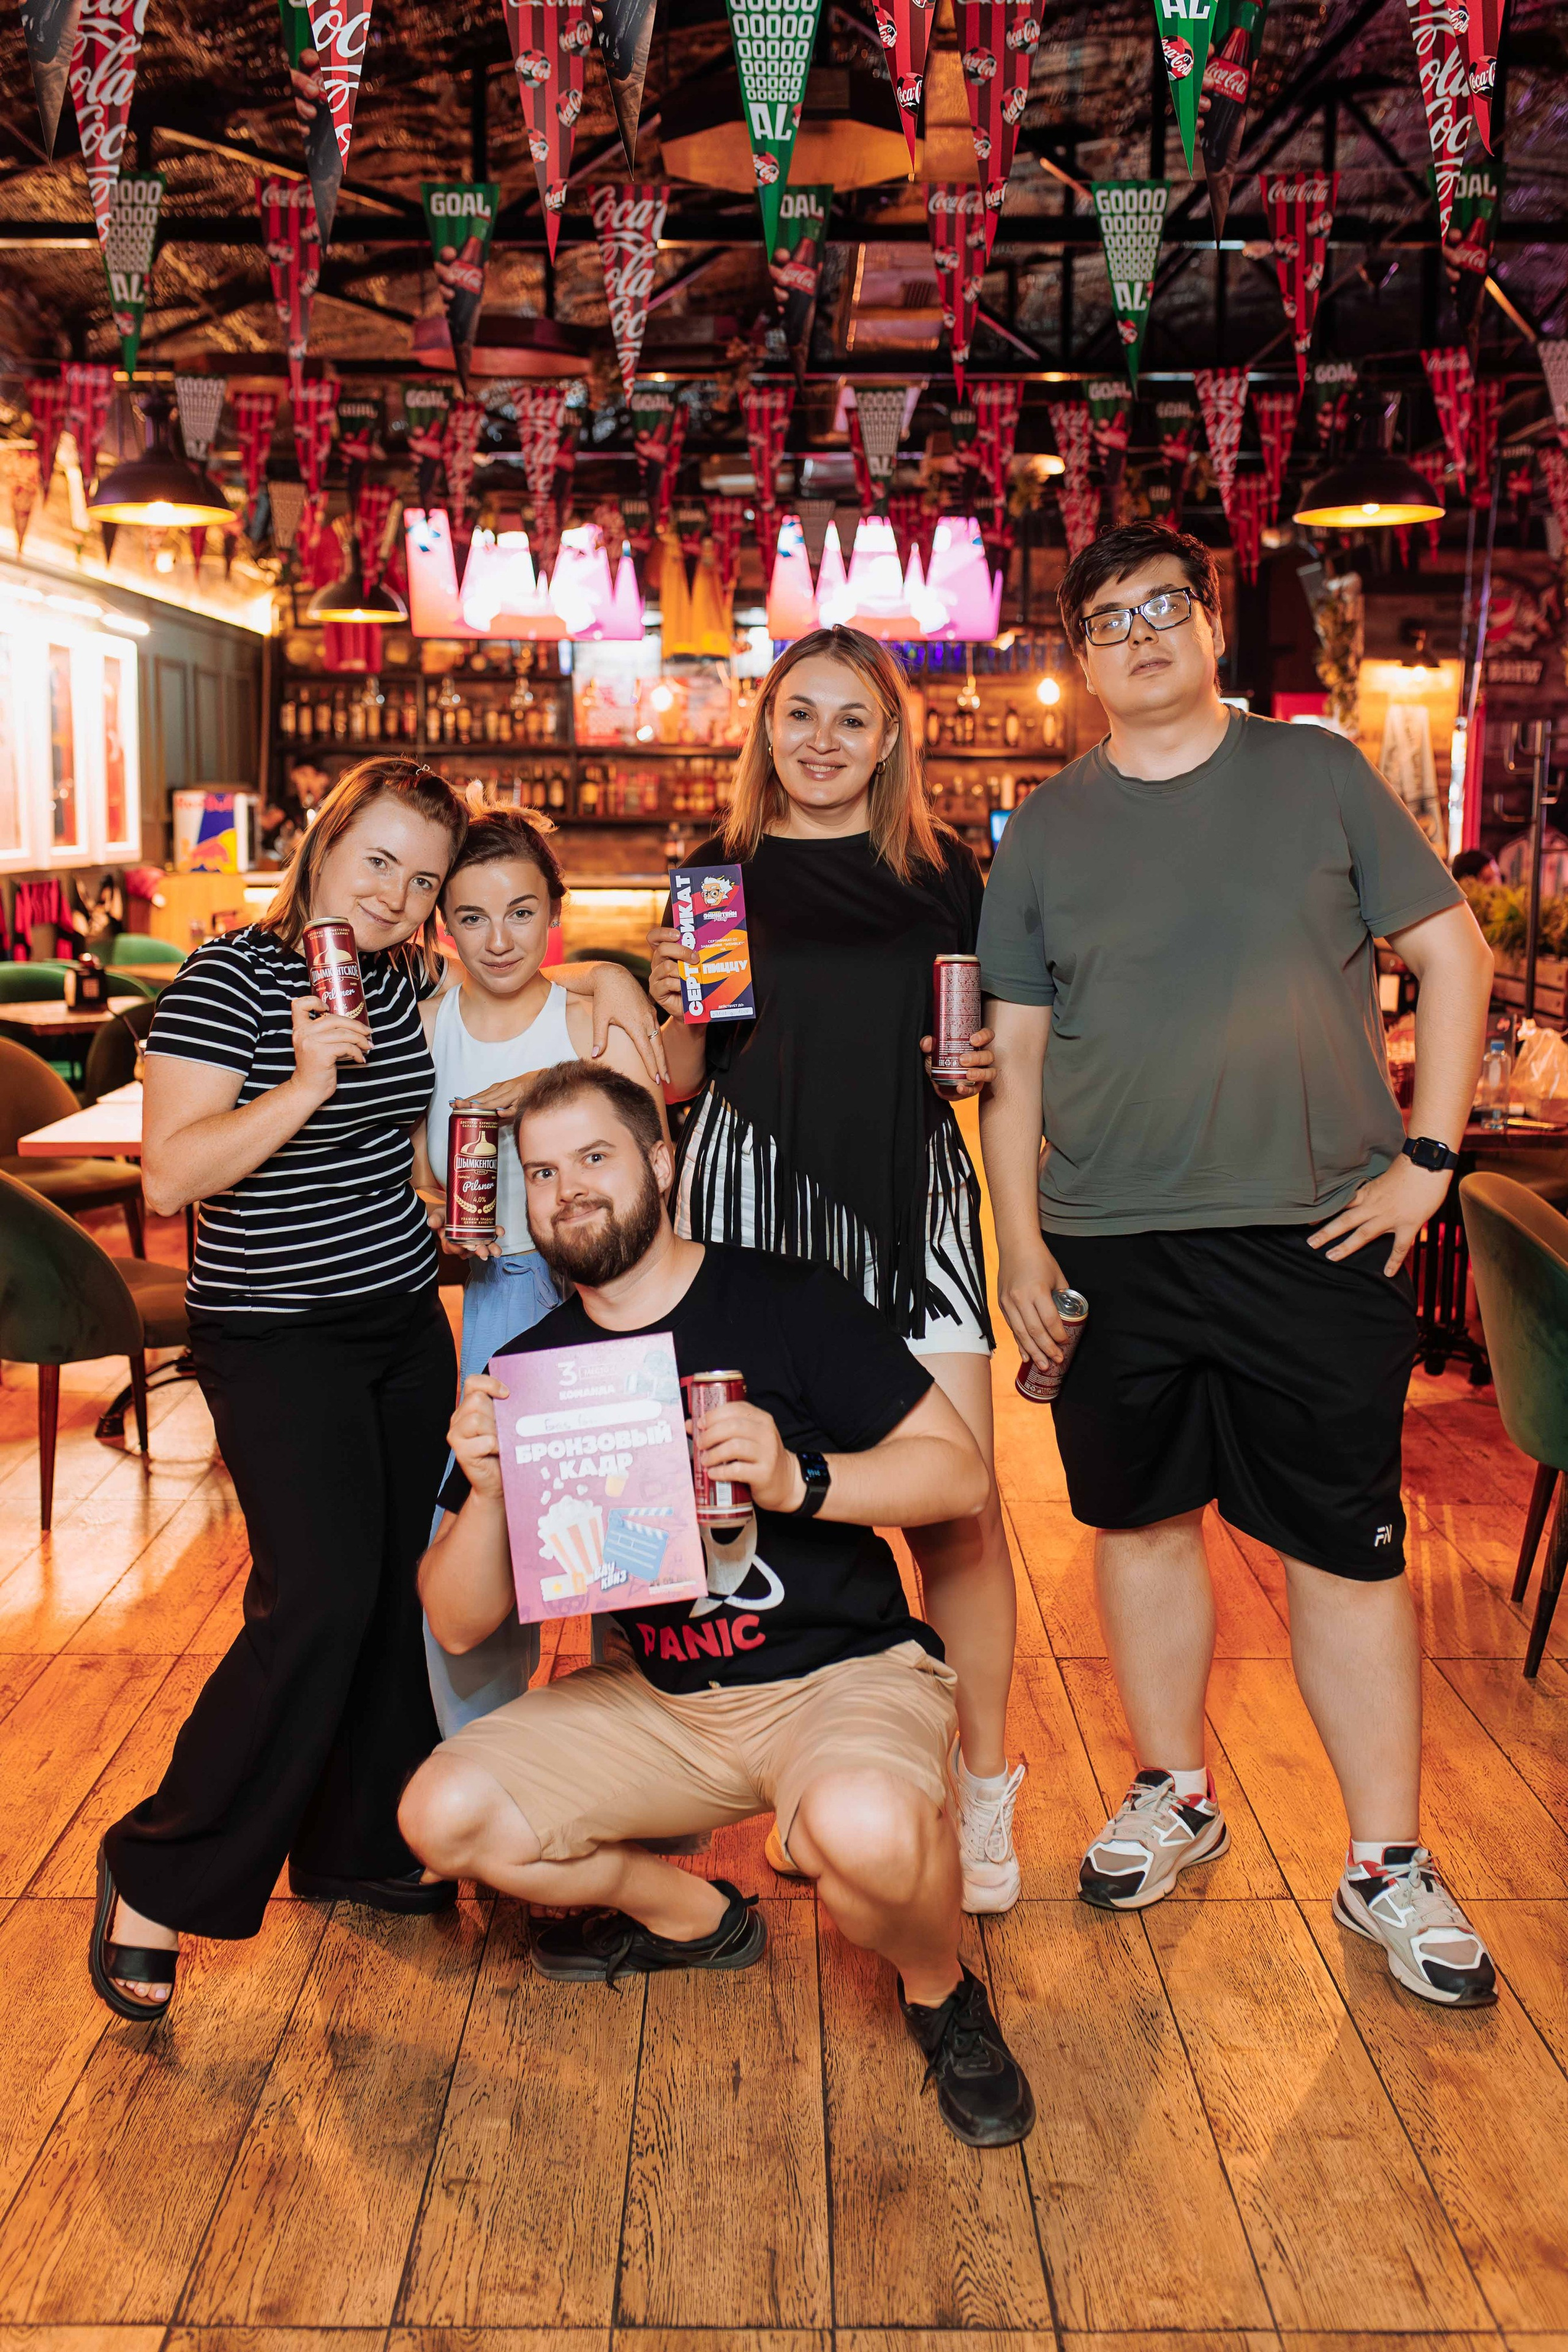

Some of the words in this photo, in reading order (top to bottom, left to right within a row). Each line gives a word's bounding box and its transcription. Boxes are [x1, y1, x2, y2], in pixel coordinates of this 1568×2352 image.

[748, 102, 792, 140] AL
[1455, 173, 1498, 198] OAL
[430, 192, 491, 217] GOAL
[780, 193, 824, 219] OAL
[1096, 188, 1167, 214] GOOOO
[1114, 281, 1147, 311] AL
[676, 875, 704, 1017] СЕРТФИКАТ
[312, 965, 359, 983] ШЫМКНТСКОЕ
[703, 959, 748, 974] ПИЦЦУ
[456, 1157, 497, 1170] ШЫМКЕНТСКО
[462, 1179, 494, 1193] Pilsner
[557, 1361, 578, 1387] 3
[559, 1385, 616, 1401] КОМАНДА
[515, 1420, 673, 1464] БРОНЗОВЫЙ
[559, 1452, 633, 1480] КАДР
[636, 1613, 766, 1662] PANIC
